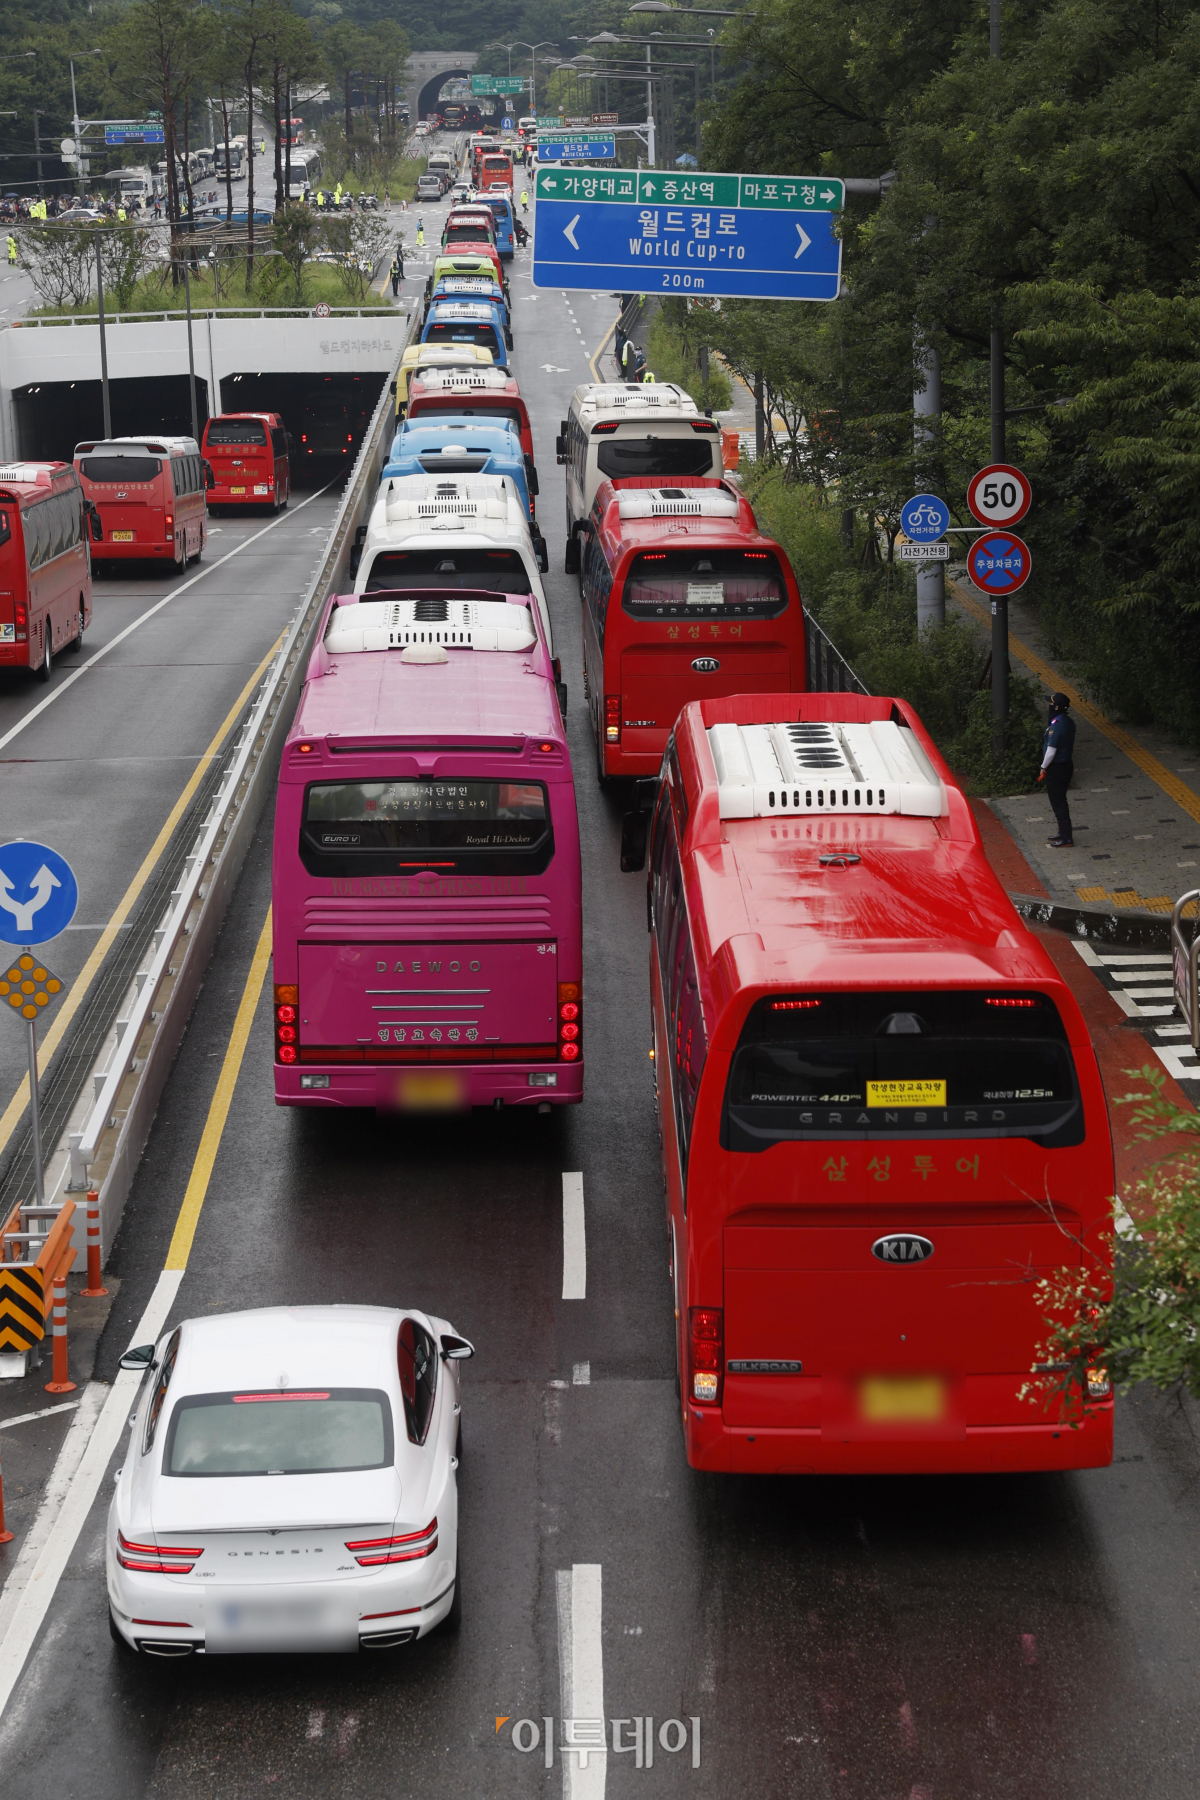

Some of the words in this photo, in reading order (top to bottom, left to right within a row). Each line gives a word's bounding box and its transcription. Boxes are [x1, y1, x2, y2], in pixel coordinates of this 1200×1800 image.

[563, 177, 635, 198] 가양대교
[661, 180, 715, 201] 증산역
[744, 183, 817, 206] 마포구청
[637, 209, 739, 239] 월드컵로
[629, 238, 680, 258] World
[686, 239, 746, 262] Cup-ro
[662, 273, 705, 289] 200m
[319, 338, 393, 355] 월드컵지하차도
[982, 482, 1017, 509] 50
[909, 526, 941, 534] 자전거전용
[903, 546, 946, 557] 자전거전용
[976, 558, 1022, 569] 주정차금지
[656, 607, 755, 615] GRANBIRD
[666, 624, 743, 639] 삼성투어
[695, 660, 716, 670] KIA
[324, 835, 349, 843] EURO
[351, 835, 359, 843] V
[466, 834, 490, 845] Royal
[492, 834, 532, 844] Hi-Decker
[331, 877, 410, 896] YOUNGNAM
[418, 877, 483, 896] EXPRESS
[488, 876, 528, 895] TOUR
[536, 943, 557, 955] 전세
[376, 960, 482, 974] DAEWOO
[377, 1027, 479, 1042] 영남고속관광
[870, 1081, 942, 1094] 학생현장교육차량
[1015, 1088, 1054, 1099] 12.5m
[750, 1093, 818, 1102] POWERTEC
[799, 1109, 1006, 1124] GRANBIRD
[821, 1154, 981, 1183] 삼성투어
[881, 1241, 927, 1260] KIA
[731, 1362, 799, 1371] SILKROAD
[227, 1547, 324, 1557] GENESIS
